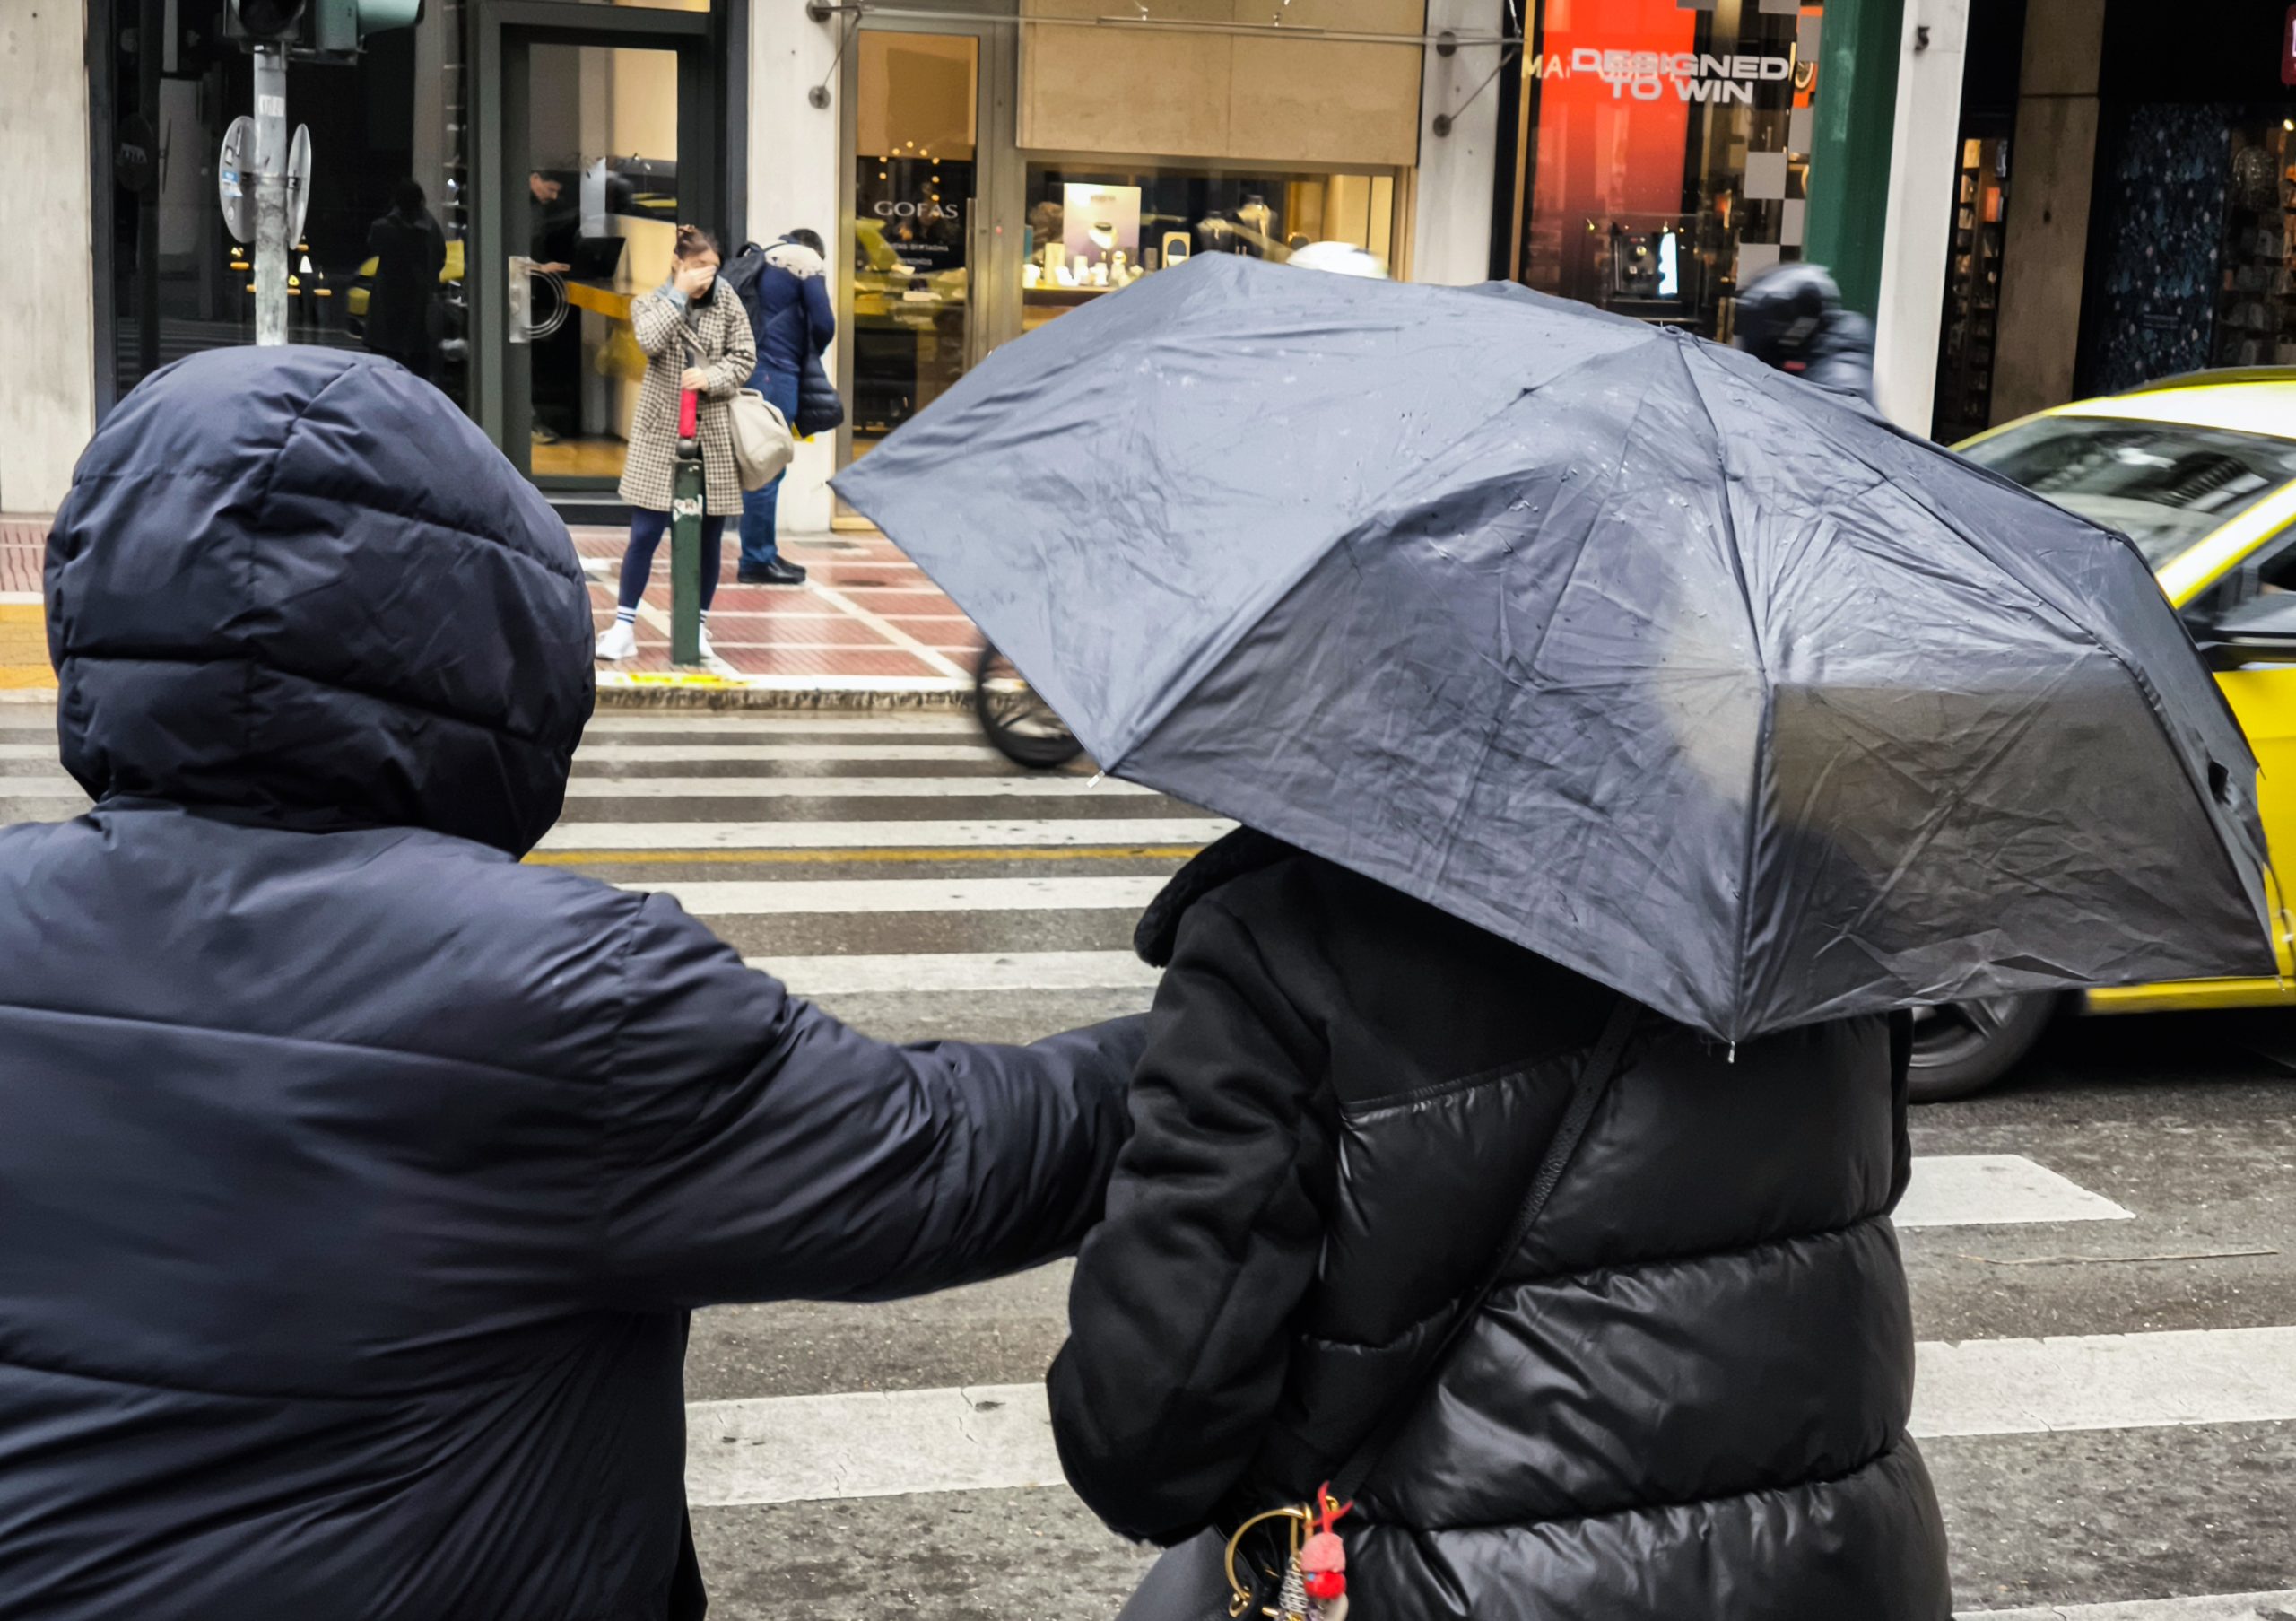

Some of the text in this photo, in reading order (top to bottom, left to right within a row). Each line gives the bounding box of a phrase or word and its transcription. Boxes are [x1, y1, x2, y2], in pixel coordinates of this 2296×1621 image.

[1572, 48, 1789, 81] DESIGNED
[1603, 76, 1753, 104] TO WIN
[874, 200, 959, 219] GOFAS
